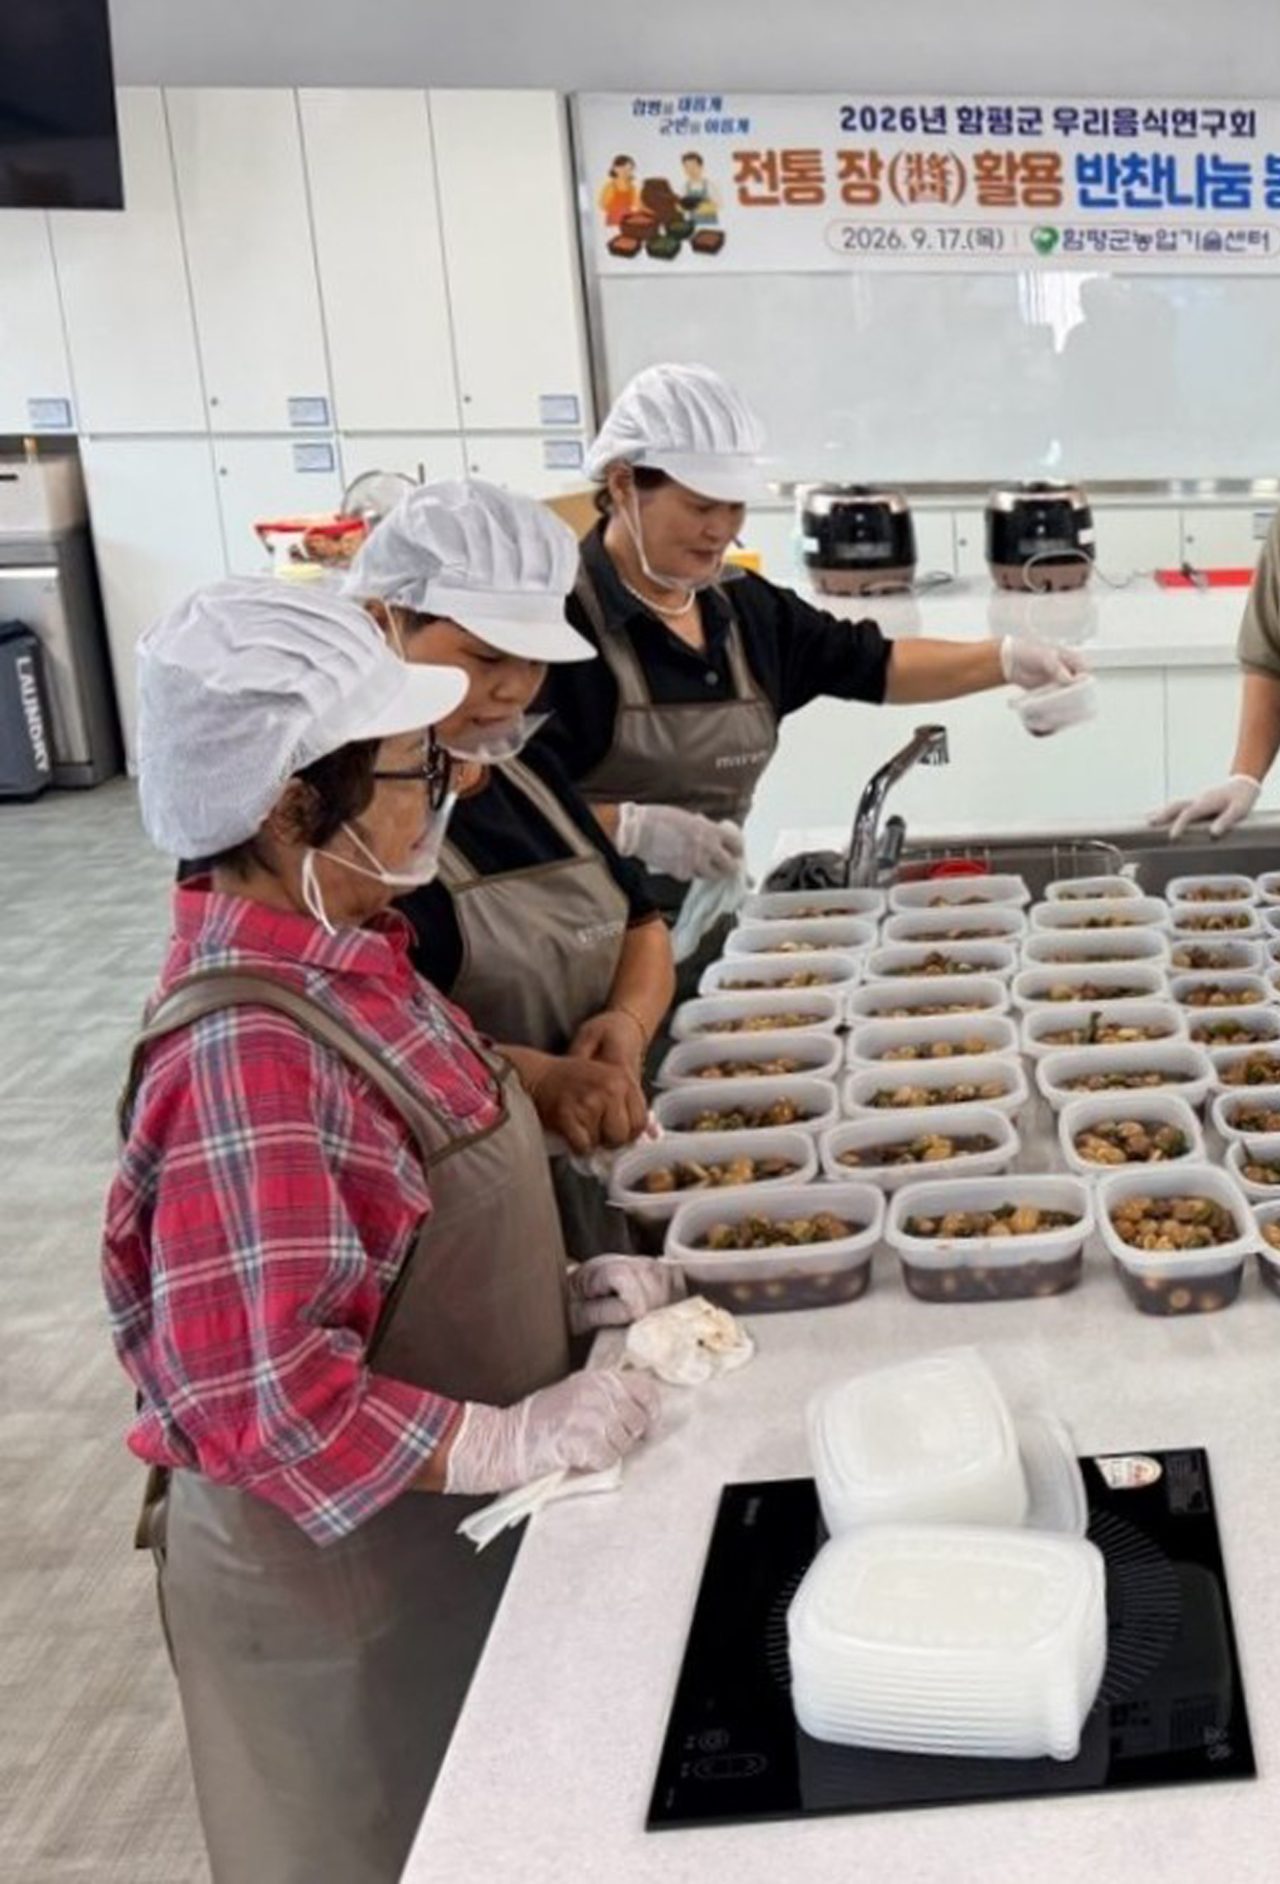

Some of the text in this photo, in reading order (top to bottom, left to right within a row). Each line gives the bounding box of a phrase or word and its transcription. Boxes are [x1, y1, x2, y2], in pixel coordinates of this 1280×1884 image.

[840, 105, 1257, 138] 2026년 함평군 우리음식연구회
[732, 148, 826, 207] 전통
[972, 149, 1064, 208] 활용
[1075, 151, 1253, 209] 반찬나눔
[1062, 227, 1271, 252] 함평군농업기술센터
[16, 655, 50, 773] LAUNDRY
